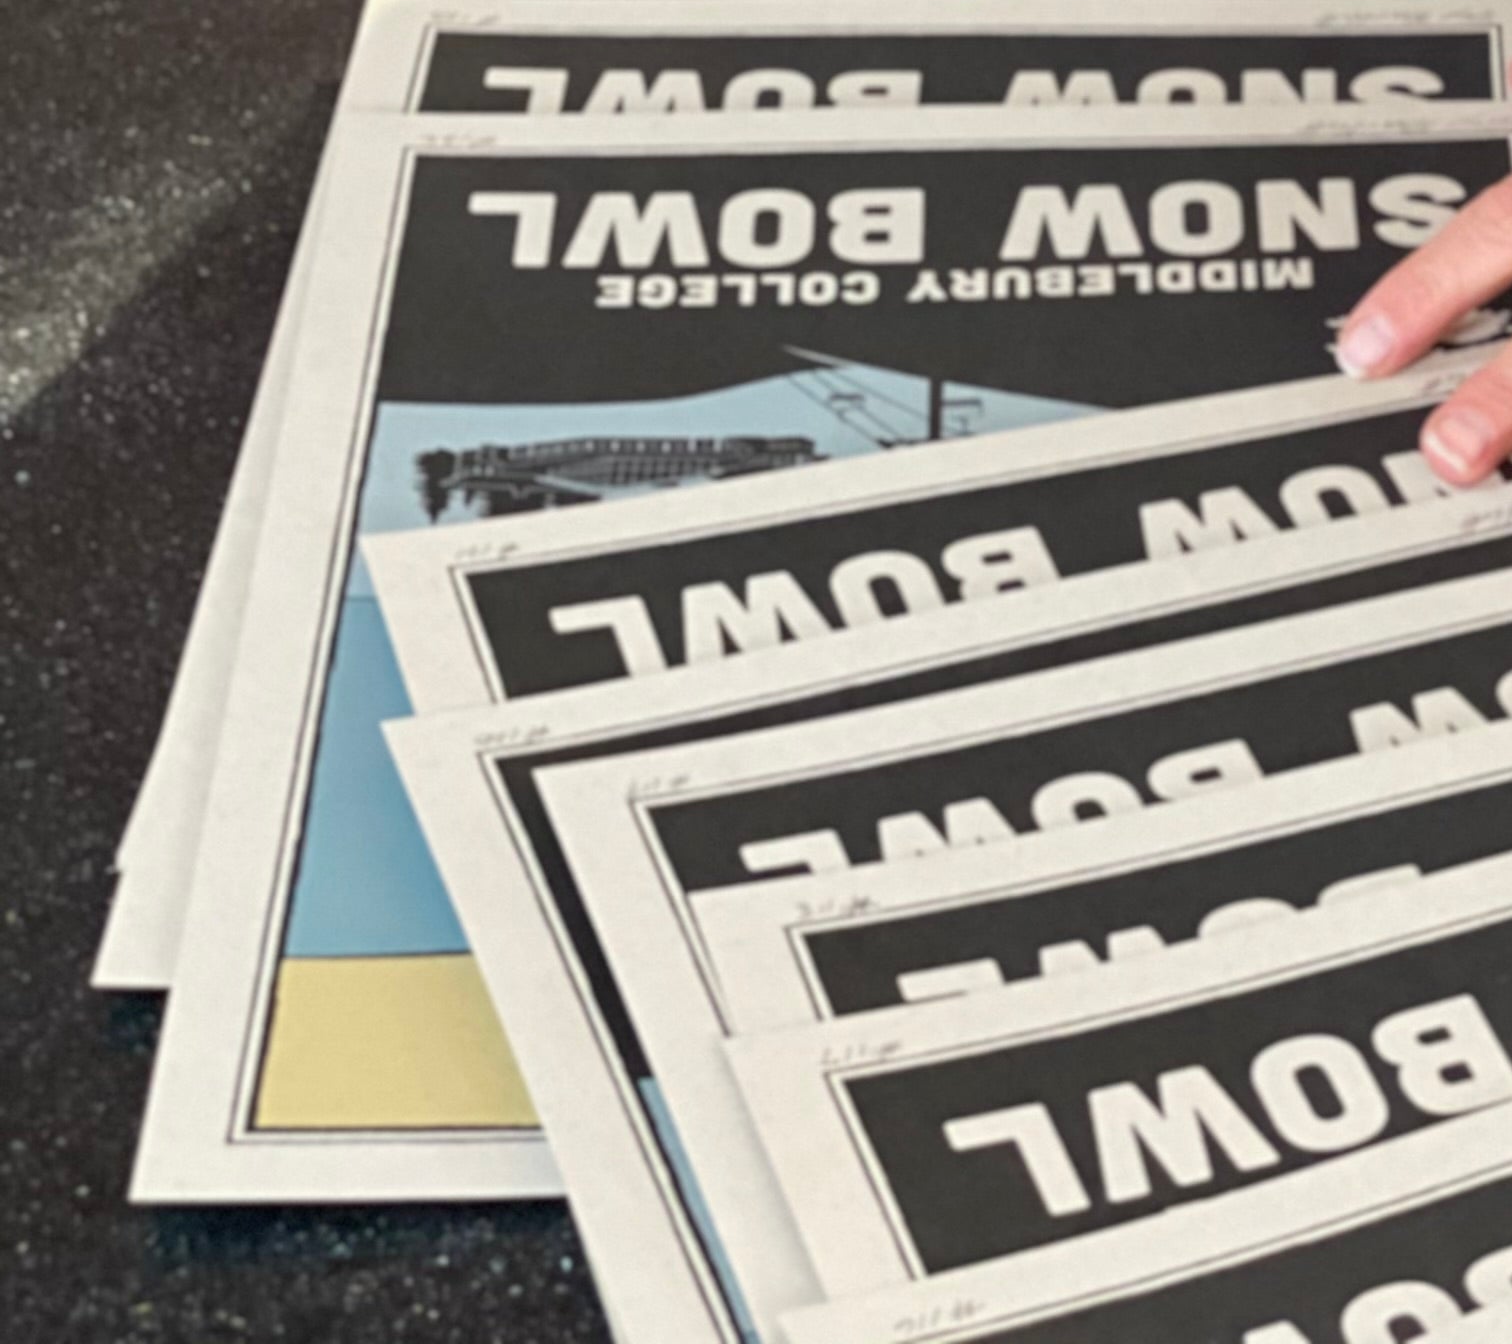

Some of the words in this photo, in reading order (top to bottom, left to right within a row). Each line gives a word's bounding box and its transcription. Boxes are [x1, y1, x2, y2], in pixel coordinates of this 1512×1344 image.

[466, 186, 926, 268] BOWL
[997, 172, 1467, 260] SNOW
[593, 269, 881, 309] COLLEGE
[905, 256, 1313, 303] MIDDLEBURY
[547, 524, 1061, 677] BOWL
